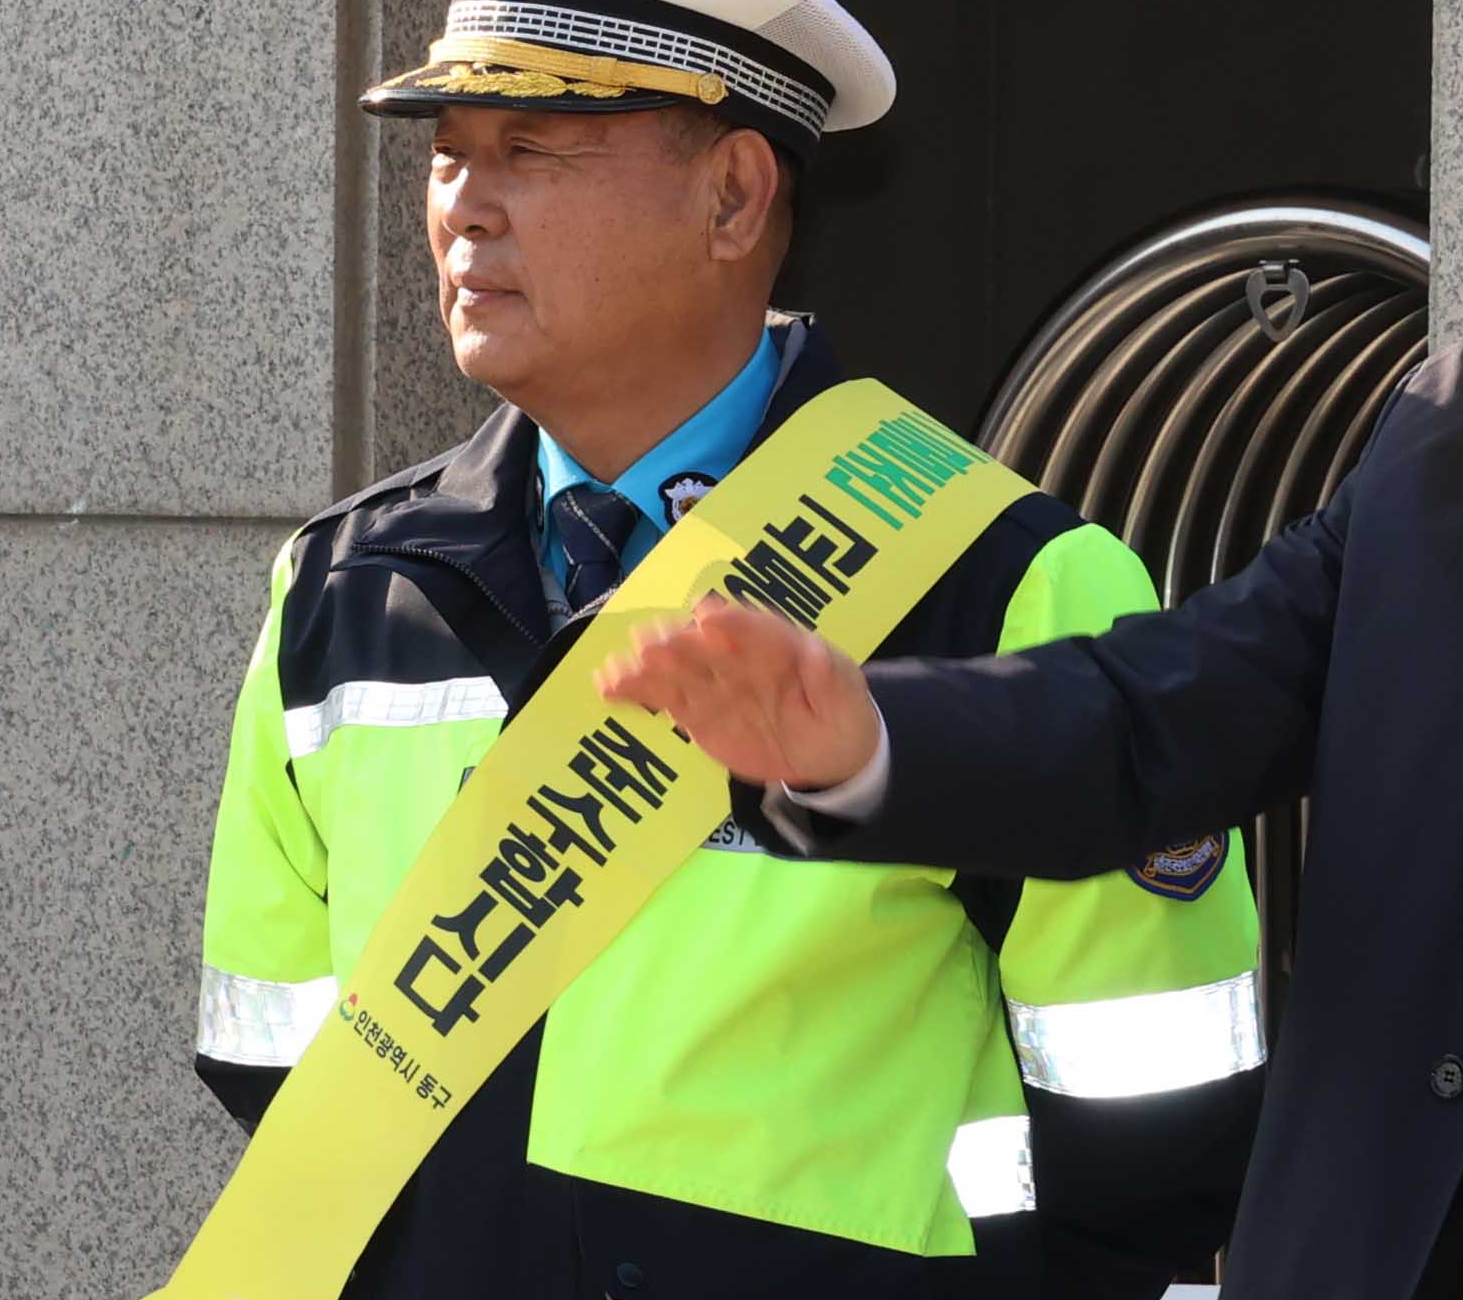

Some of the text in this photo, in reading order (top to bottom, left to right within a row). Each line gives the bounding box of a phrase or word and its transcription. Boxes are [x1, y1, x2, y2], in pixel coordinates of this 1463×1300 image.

[394, 715, 678, 1036] 준수합시다
[357, 1009, 452, 1111] 인천광역시 동구
